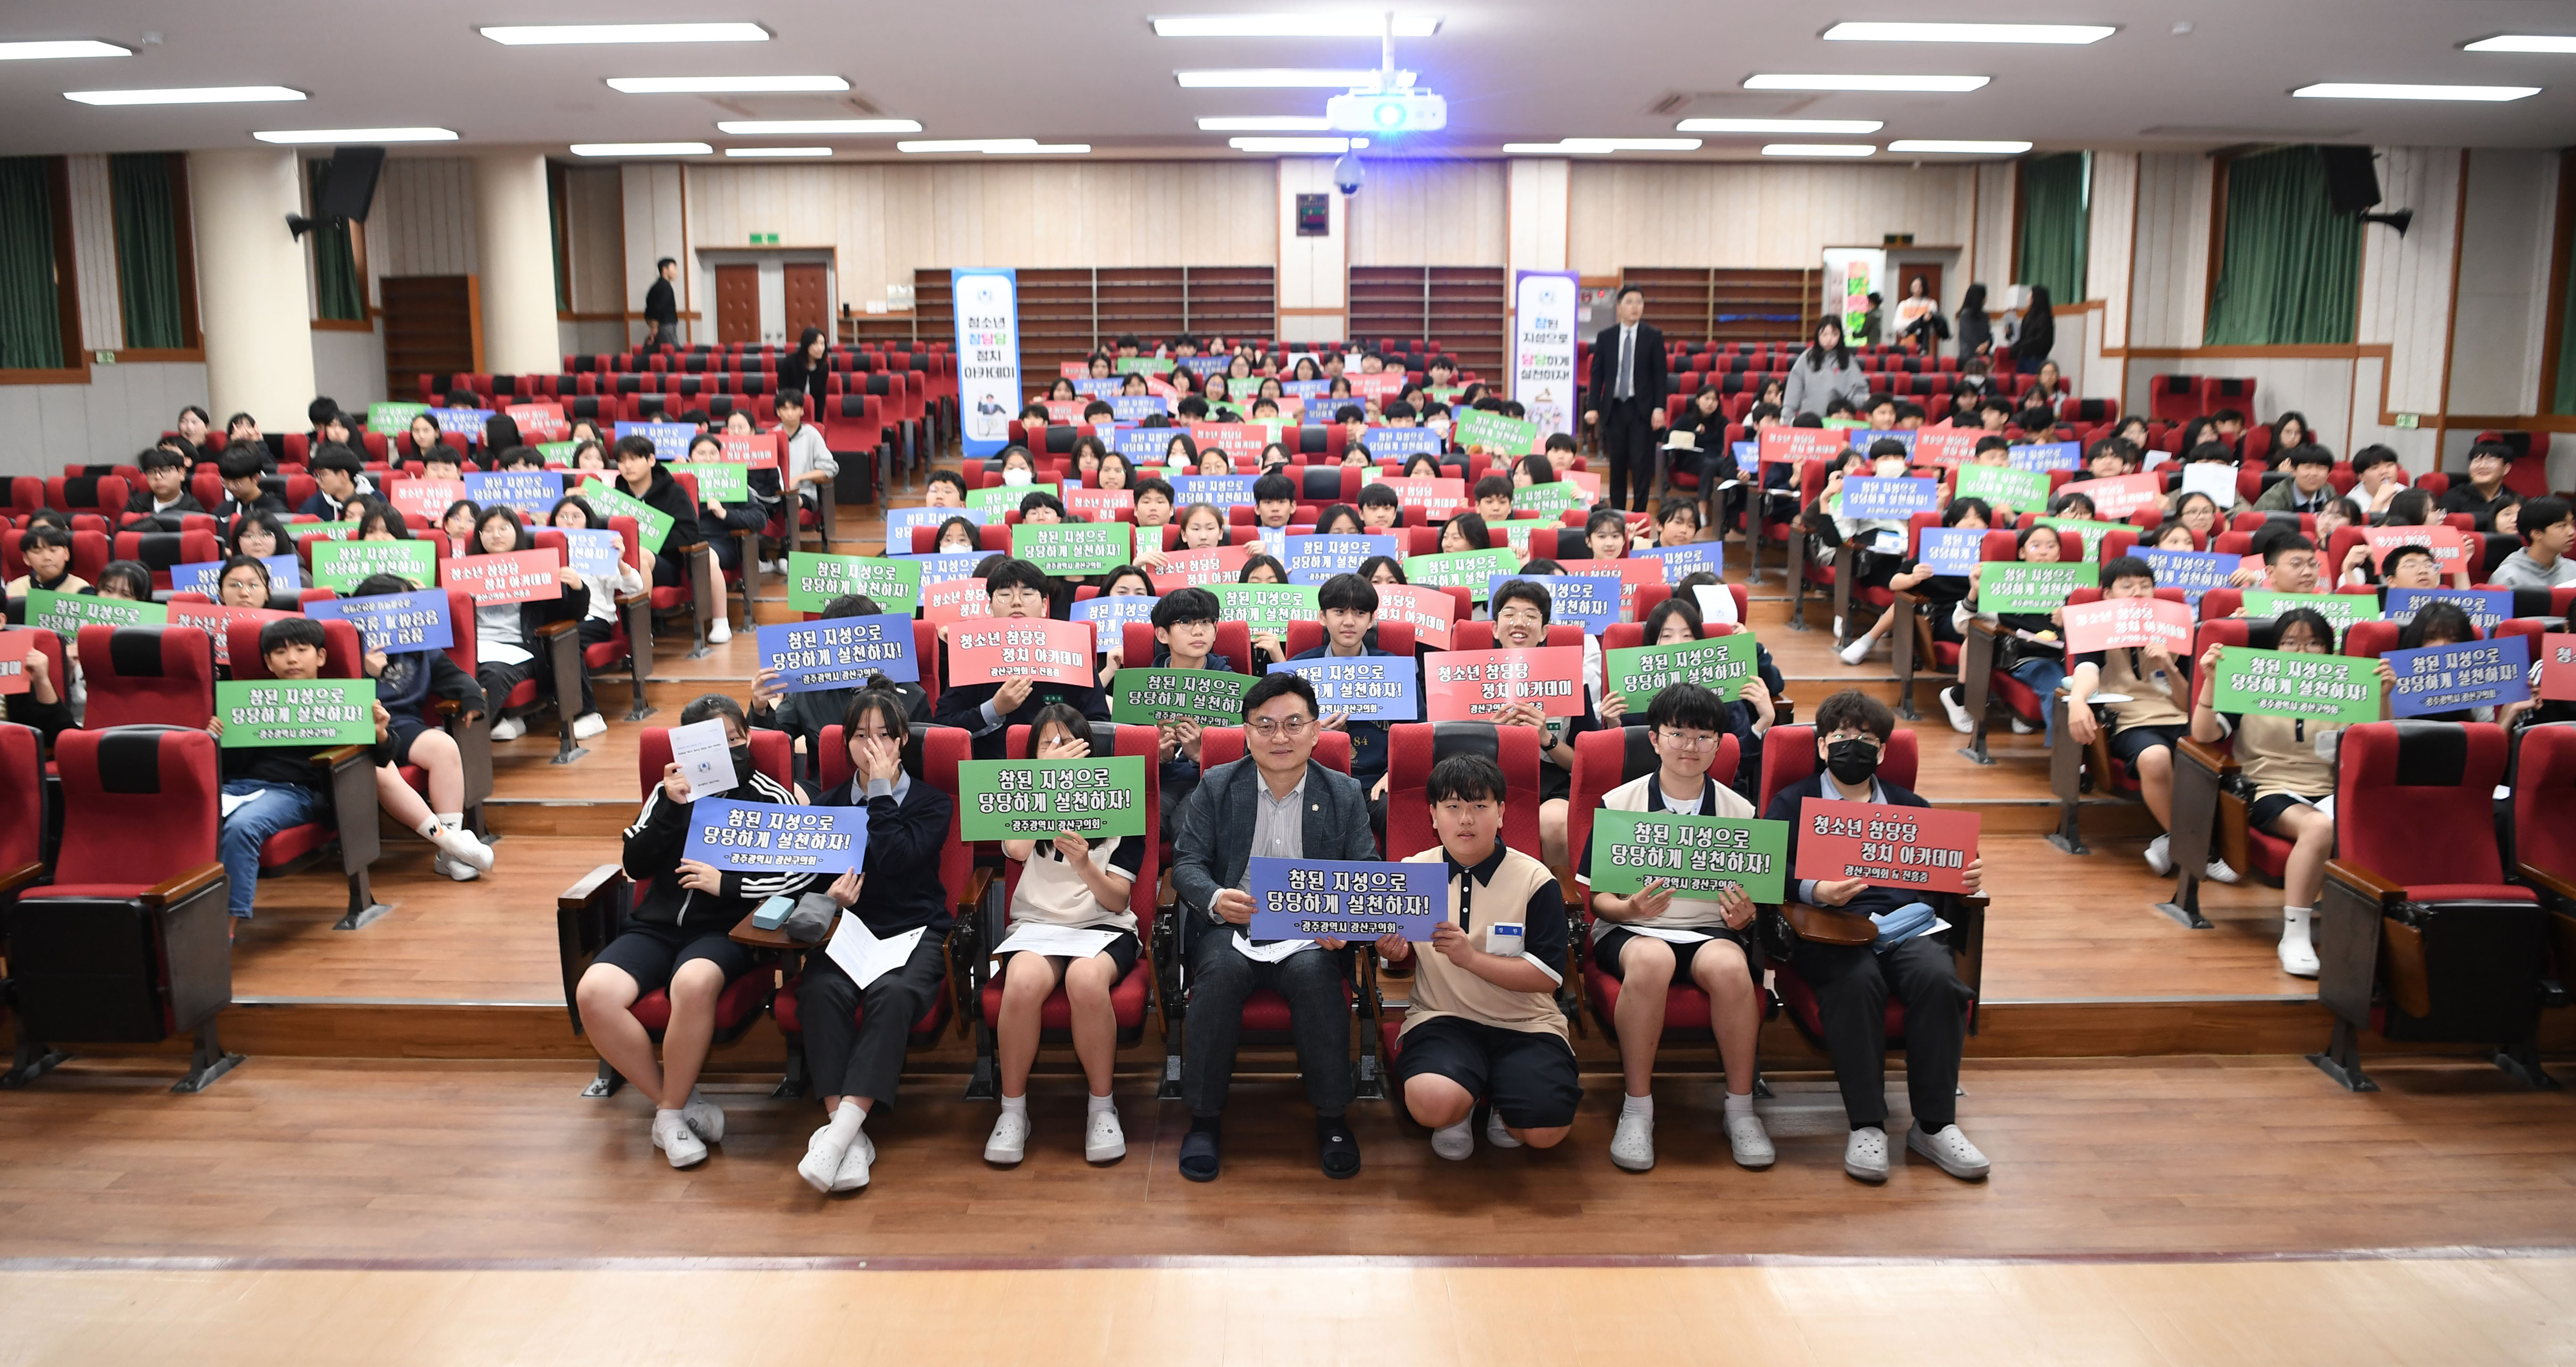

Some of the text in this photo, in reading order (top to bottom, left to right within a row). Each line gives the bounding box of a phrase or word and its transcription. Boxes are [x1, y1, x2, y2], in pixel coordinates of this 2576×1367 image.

[968, 316, 1006, 329] 청소년
[976, 350, 1001, 362] 정치
[965, 366, 1015, 379] 아카데미
[1038, 529, 1108, 544] 참된 지성으로
[1024, 544, 1121, 559] 당당하게 실천하자!
[1303, 541, 1372, 555] 참된 지성으로
[817, 561, 897, 582] 참된 지성으로
[1189, 558, 1221, 573] 참당당
[1291, 555, 1332, 569] 당당하게
[1428, 555, 1498, 573] 참된 지성으로
[801, 576, 910, 598] 당당하게 실천하자!
[1186, 572, 1207, 586] 정치
[932, 591, 960, 607] 청소년
[1225, 591, 1304, 608] 참된 지성으로
[1380, 593, 1417, 609] 참당당
[1554, 599, 1608, 616] 실천하자!
[960, 604, 980, 618] 정치
[1089, 605, 1110, 620] 참된
[1377, 608, 1446, 633] 정치 아카데미
[787, 624, 883, 651] 참된 지성으로
[960, 630, 1047, 650] 청소년 참당당
[771, 641, 903, 672] 당당하게 실천하자!
[1002, 647, 1084, 668] 정치 아카데미
[1640, 645, 1730, 673] 참된 지성으로
[2412, 647, 2501, 675] 참된 지성으로
[801, 671, 840, 685] 광주광역시
[990, 666, 1028, 677] 광산구의회
[1328, 664, 1385, 681] 지성으로
[1437, 662, 1529, 683] 청소년 참당당
[1623, 660, 1748, 693] 당당하게 실천하자!
[2250, 656, 2350, 682] 참된 지성으로
[2396, 663, 2519, 695] 당당하게 실천하자!
[1147, 674, 1241, 697] 참된 지성으로
[1339, 682, 1403, 699] 실천하자!
[1481, 680, 1573, 700] 정치 아카데미
[2231, 673, 2368, 702] 당당하게 실천하자!
[248, 687, 345, 707] 참된 지성으로
[1128, 690, 1187, 708] 당당하게
[231, 705, 363, 725] 당당하게 실천하자!
[1354, 735, 1368, 747] 84
[998, 767, 1110, 791] 참된 지성으로
[978, 789, 1132, 814] 당당하게 실천하자!
[728, 808, 835, 832] 참된 지성으로
[1011, 817, 1101, 832] 광주광역시 광산구의회
[1813, 814, 1919, 843] 청소년 참당당
[703, 826, 851, 850] 당당하게 실천하자!
[1633, 821, 1751, 849] 참된 지성으로
[730, 853, 817, 866] 광주광역시 광산구의회
[1610, 843, 1772, 874] 당당하게 실천하자!
[1861, 841, 1965, 870] 정치 아카데미
[1288, 869, 1408, 893] 참된 지성으로
[1844, 864, 1890, 880] 광산구의회
[1890, 868, 1900, 880] &
[1266, 890, 1430, 917] 당당하게 실천하자!
[1301, 920, 1397, 934] 광주광역시 광산구의회
